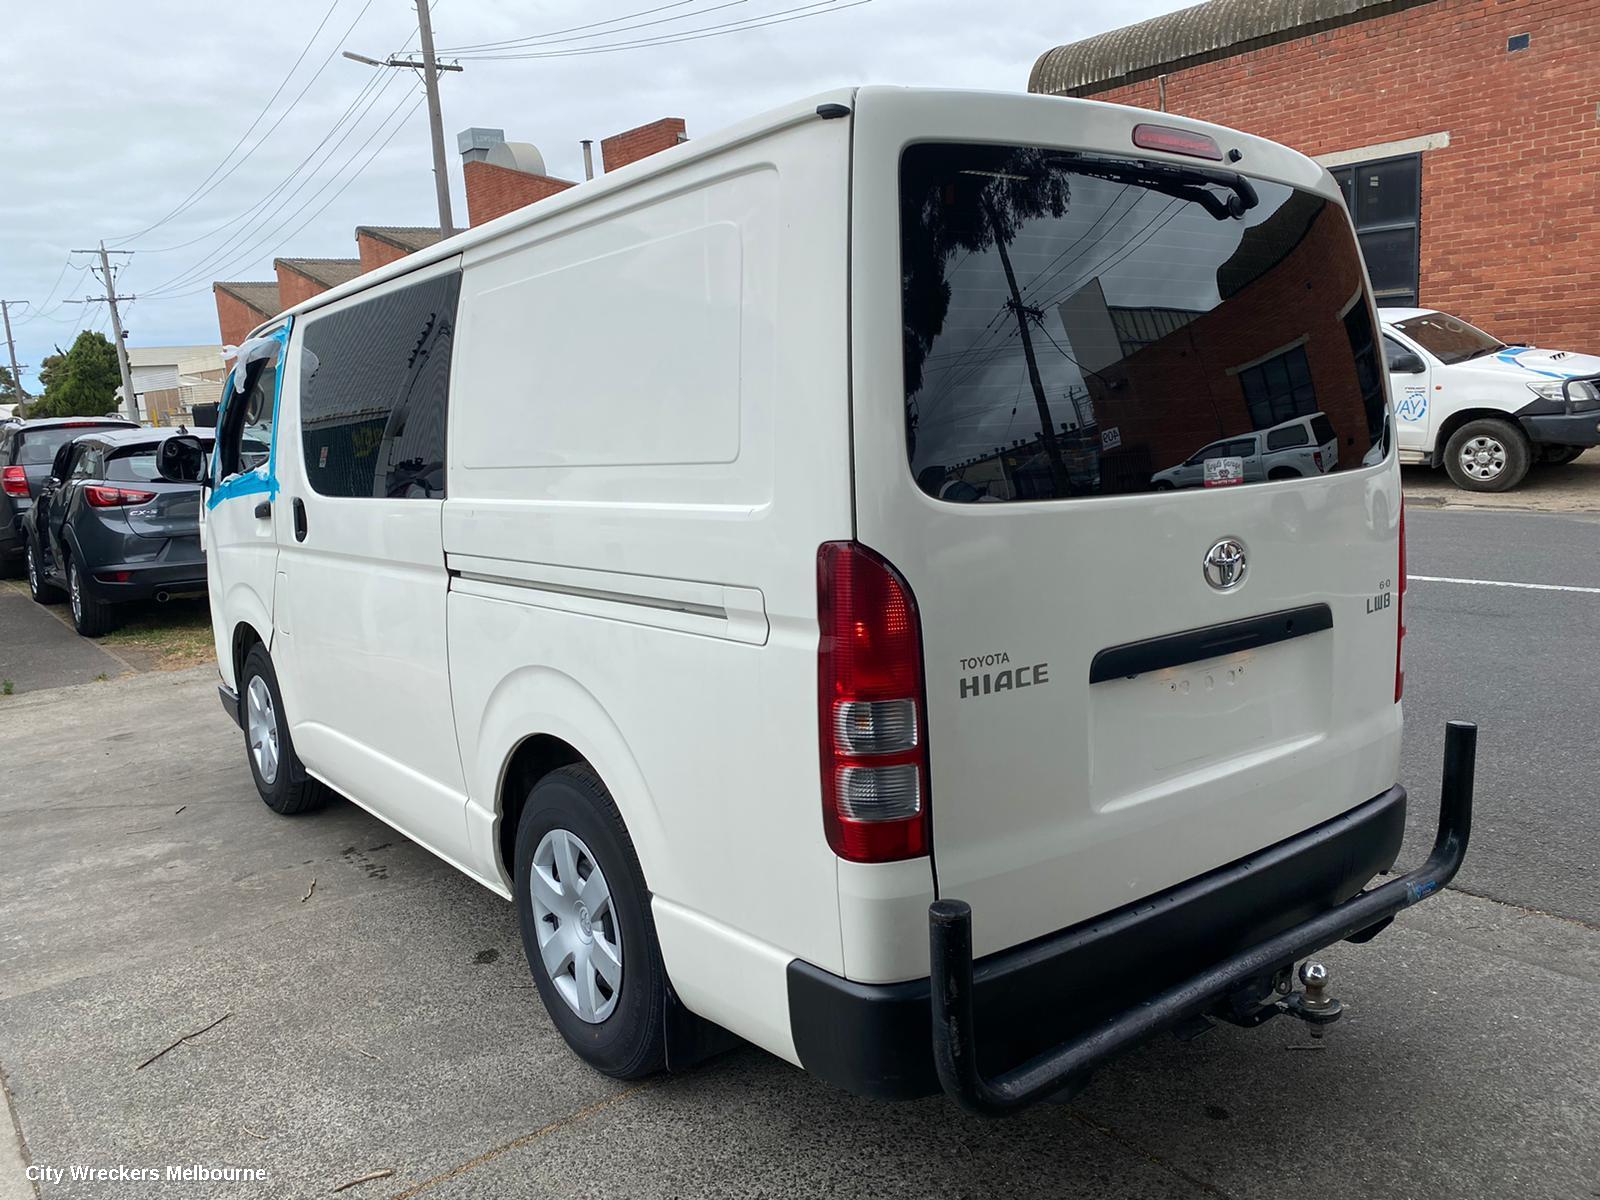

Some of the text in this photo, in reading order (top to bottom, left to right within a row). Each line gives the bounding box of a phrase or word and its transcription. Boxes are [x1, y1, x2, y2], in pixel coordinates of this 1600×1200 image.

[1394, 399, 1421, 415] AY
[1366, 592, 1391, 614] LWB
[960, 652, 1010, 670] TOYOTA
[960, 663, 1049, 699] HIACE
